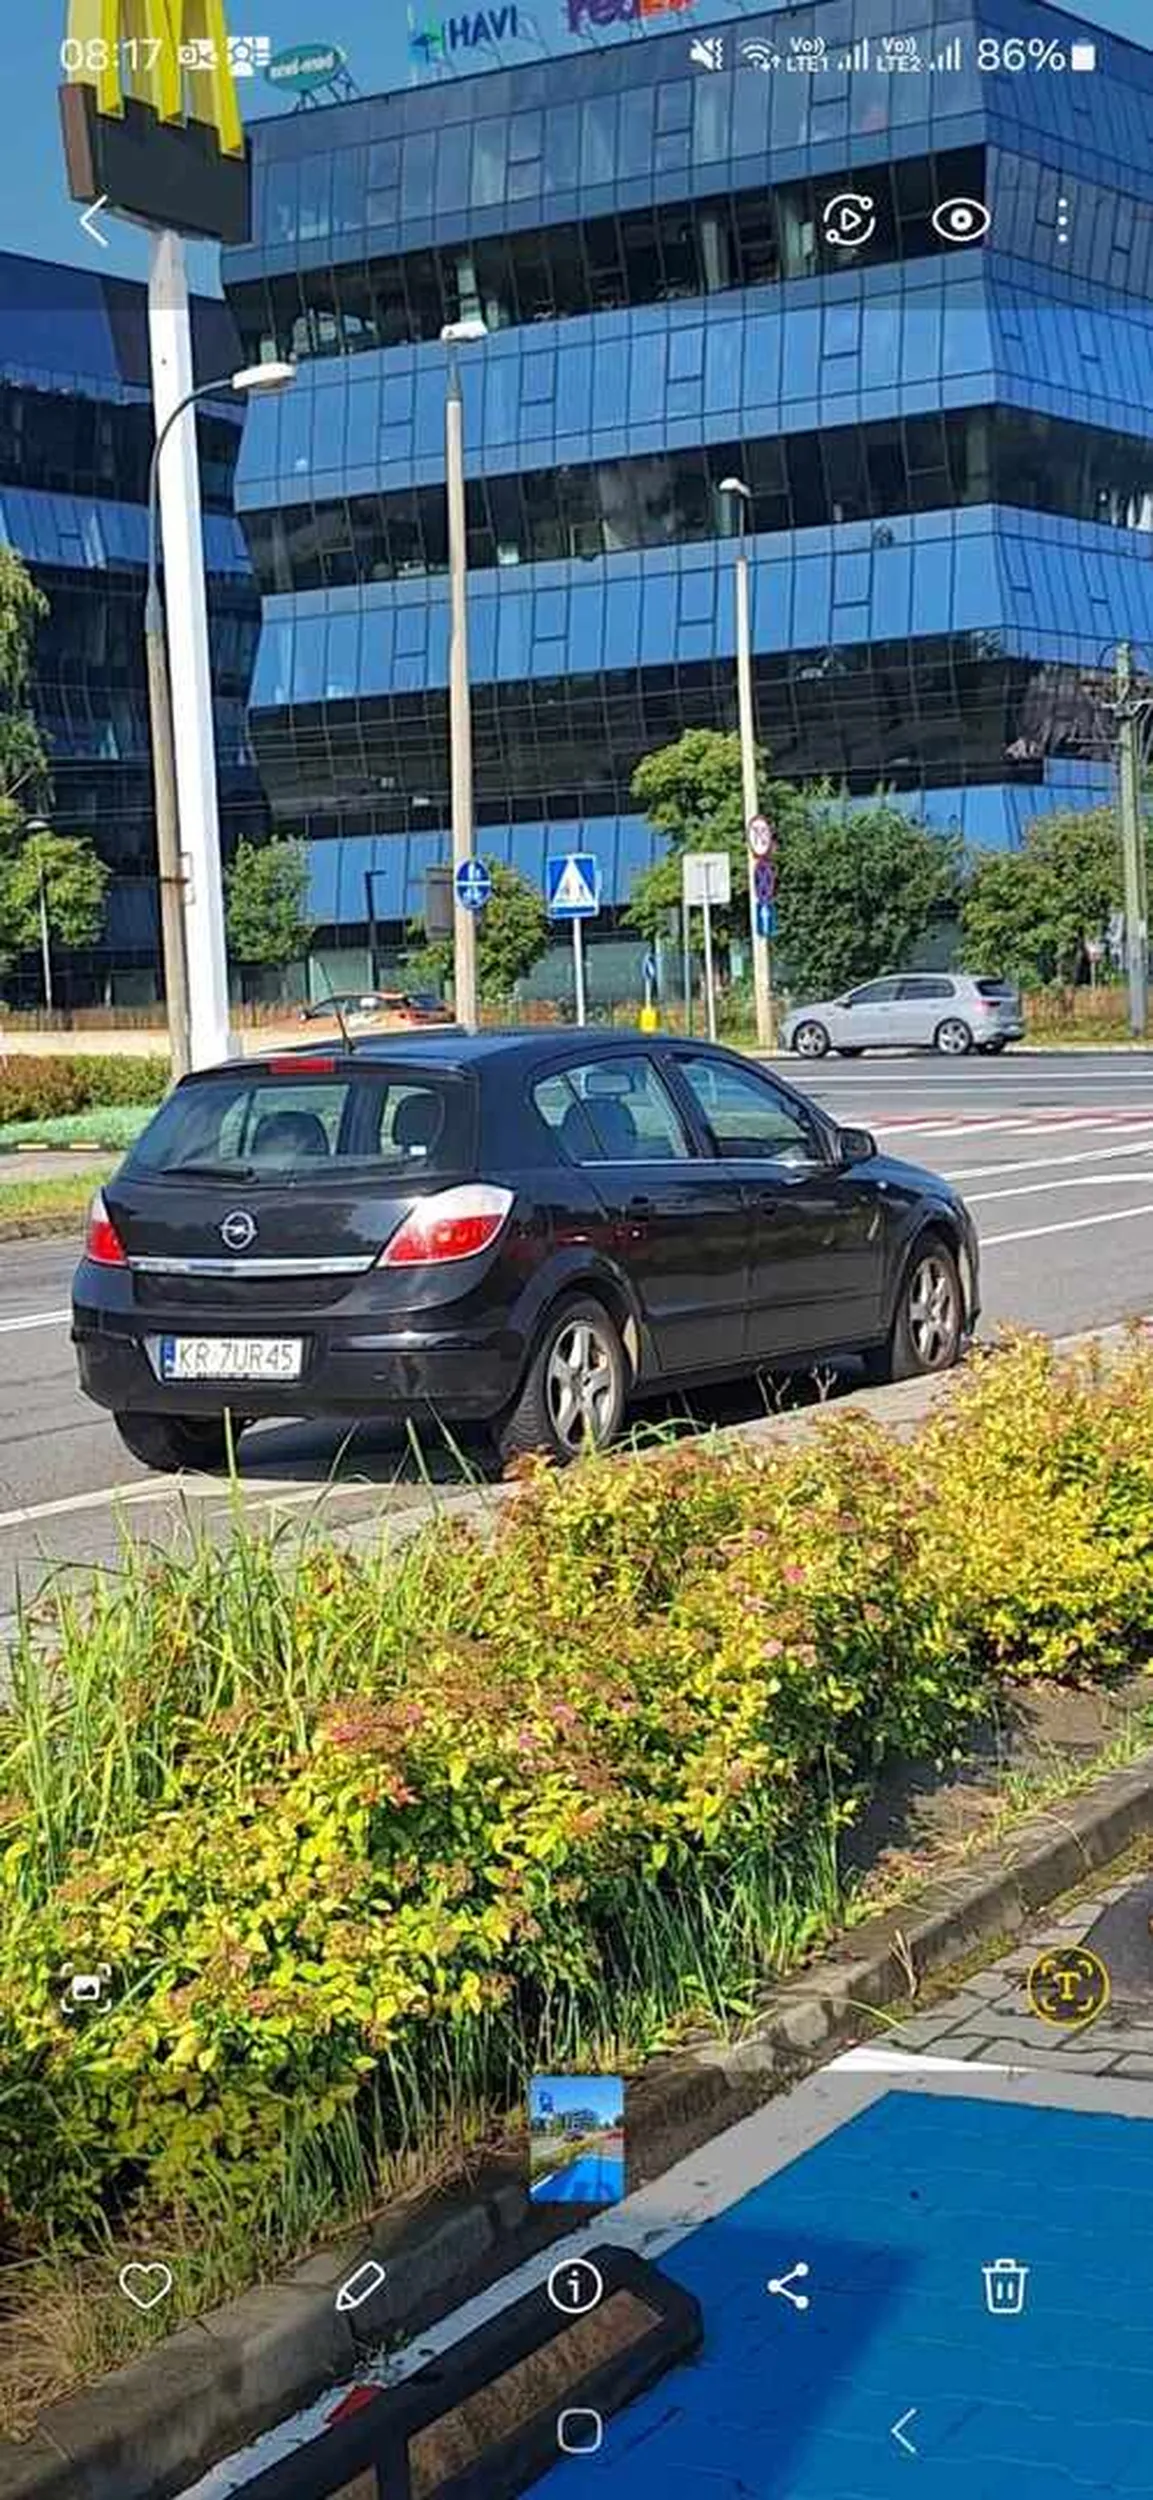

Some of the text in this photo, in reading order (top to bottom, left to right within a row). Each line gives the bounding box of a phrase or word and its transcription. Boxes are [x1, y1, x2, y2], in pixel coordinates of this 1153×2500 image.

[449, 4, 518, 51] HAVI
[180, 1341, 294, 1371] KR 7UR45
